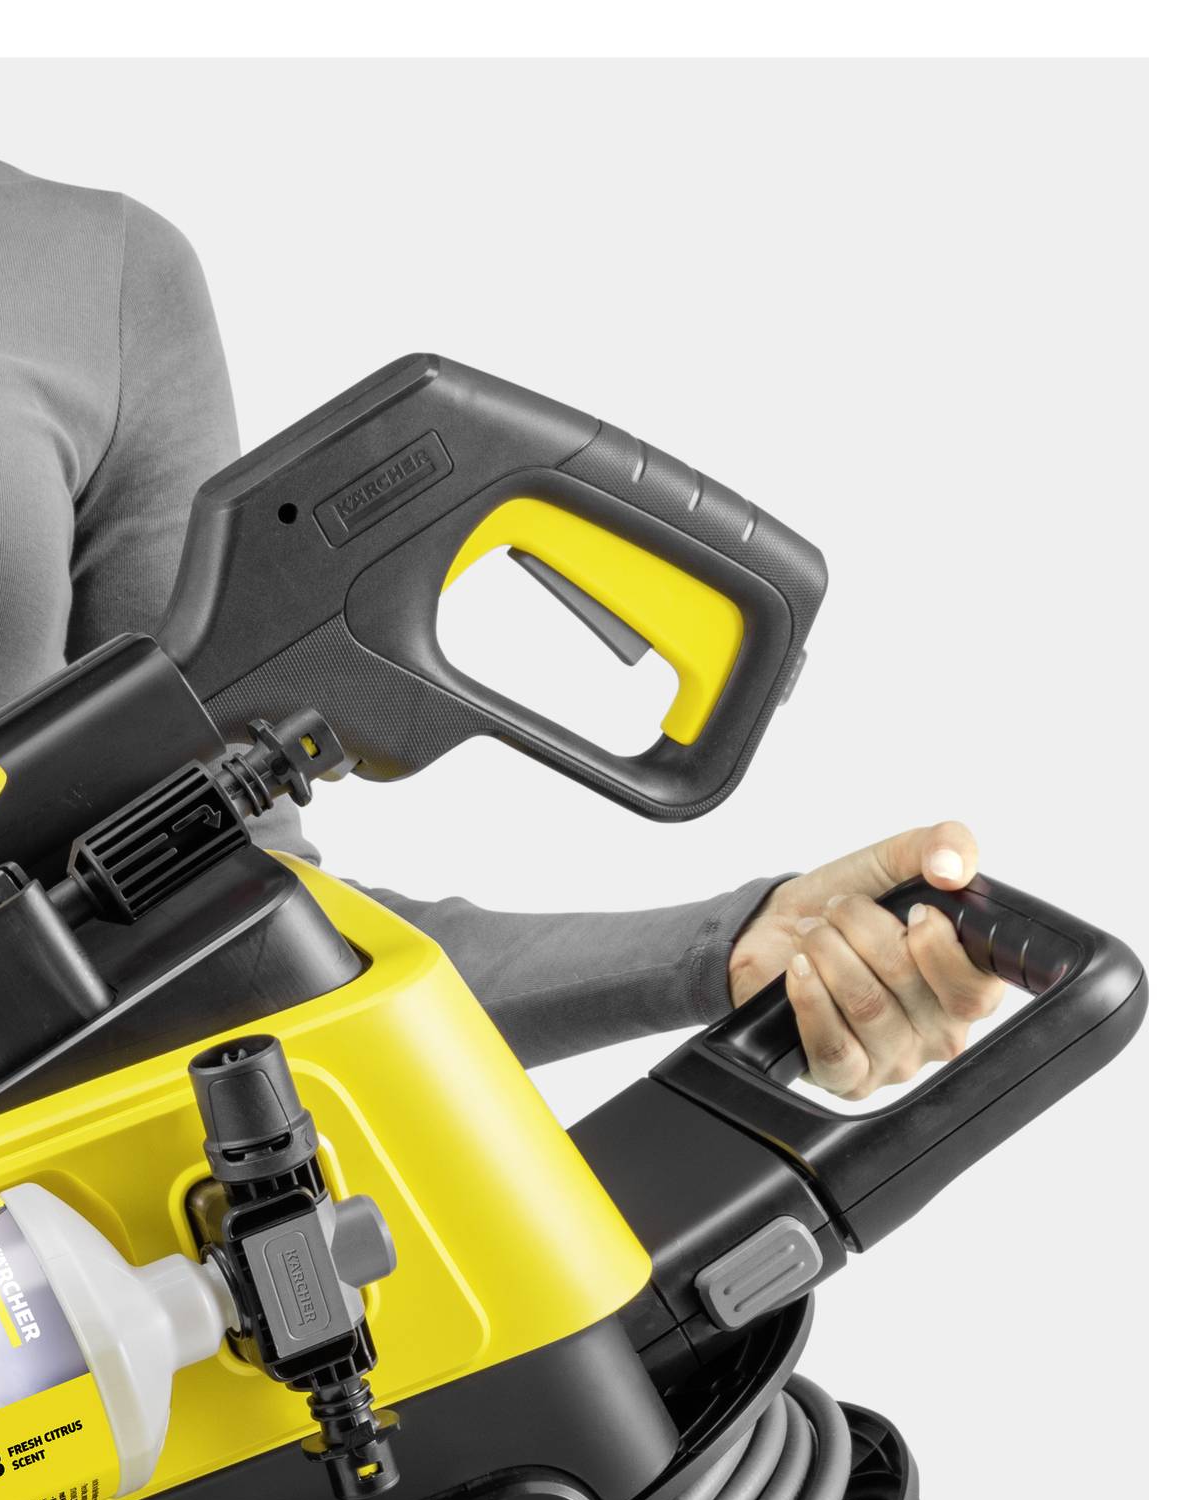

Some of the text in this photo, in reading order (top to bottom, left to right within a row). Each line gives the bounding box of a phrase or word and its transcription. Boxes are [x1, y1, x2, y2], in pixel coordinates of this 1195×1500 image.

[7, 1436, 43, 1457] FRESH
[44, 1420, 83, 1442] CITRUS
[12, 1449, 45, 1470] SCENT
